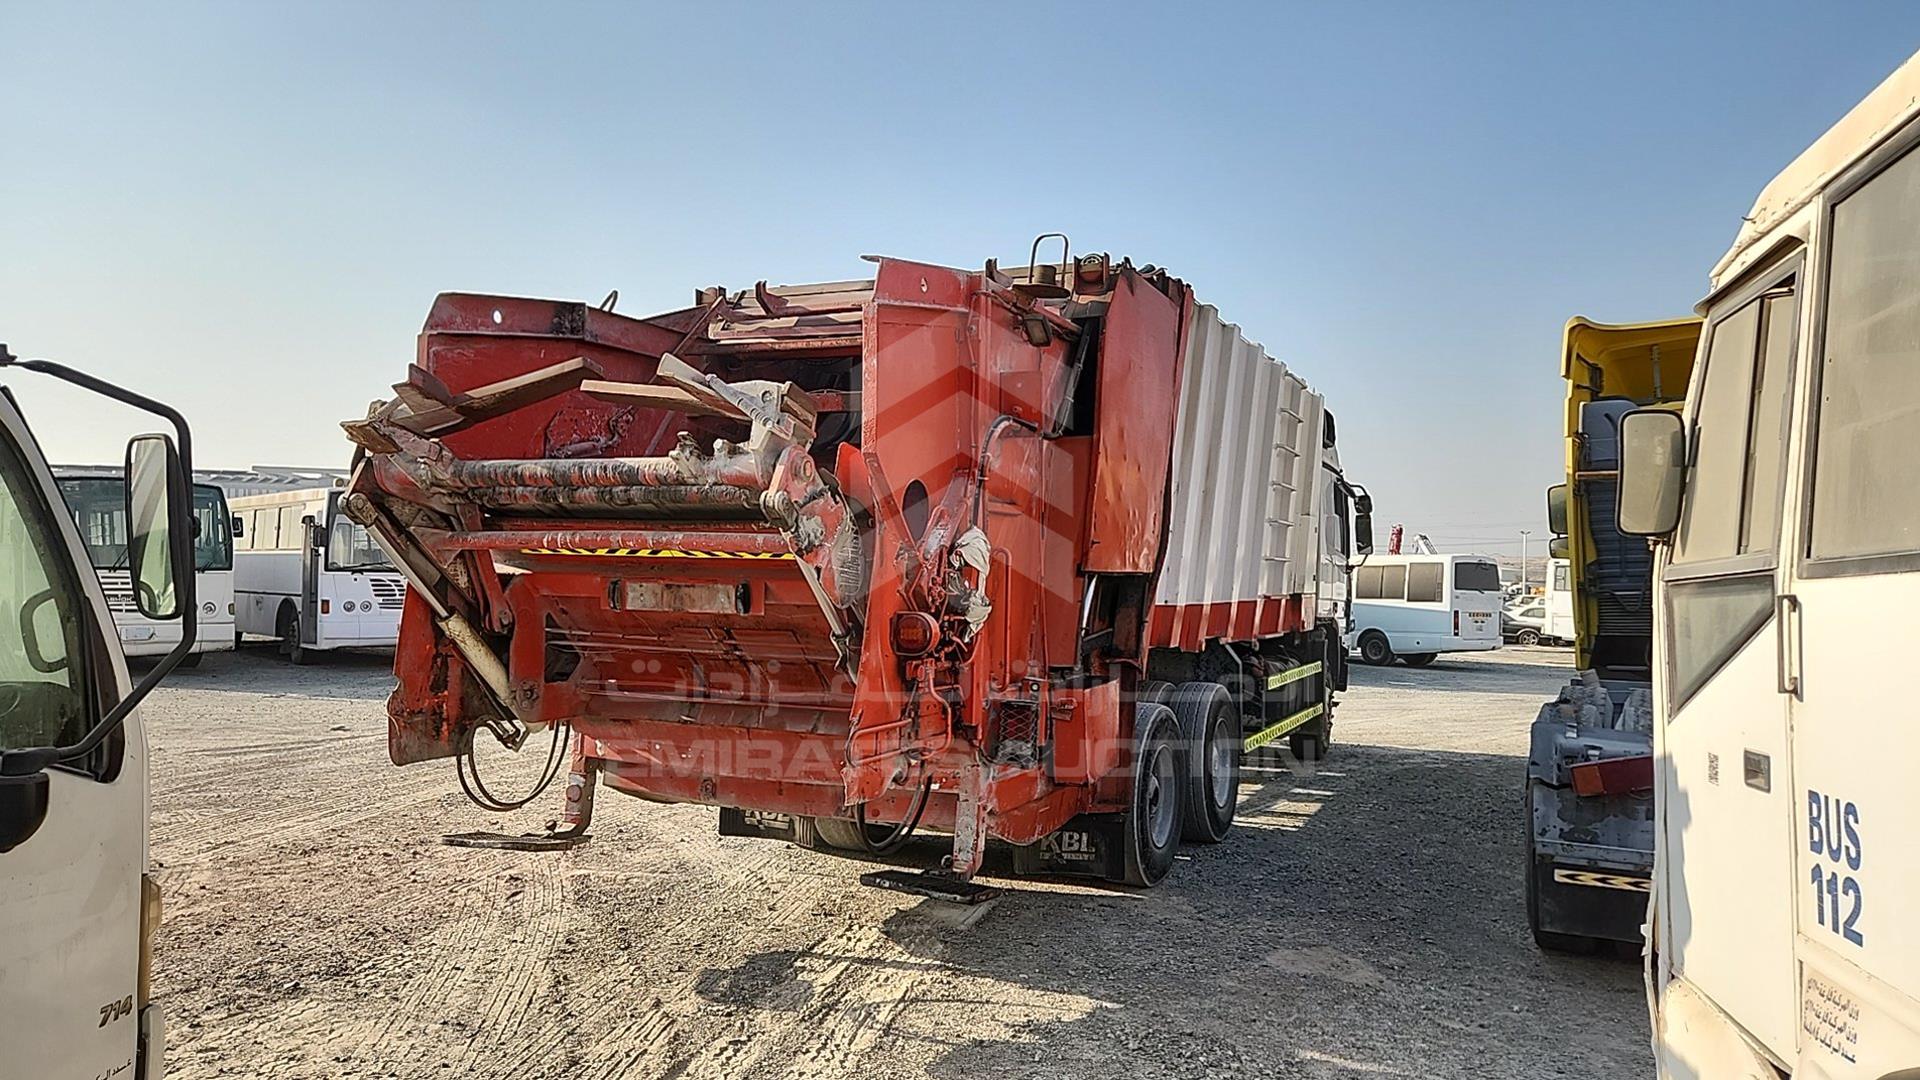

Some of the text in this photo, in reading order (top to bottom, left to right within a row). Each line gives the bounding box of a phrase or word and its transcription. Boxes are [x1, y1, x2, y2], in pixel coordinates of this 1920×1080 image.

[1808, 789, 1861, 871] BUS
[1811, 862, 1863, 948] 112
[98, 993, 133, 1029] 714
